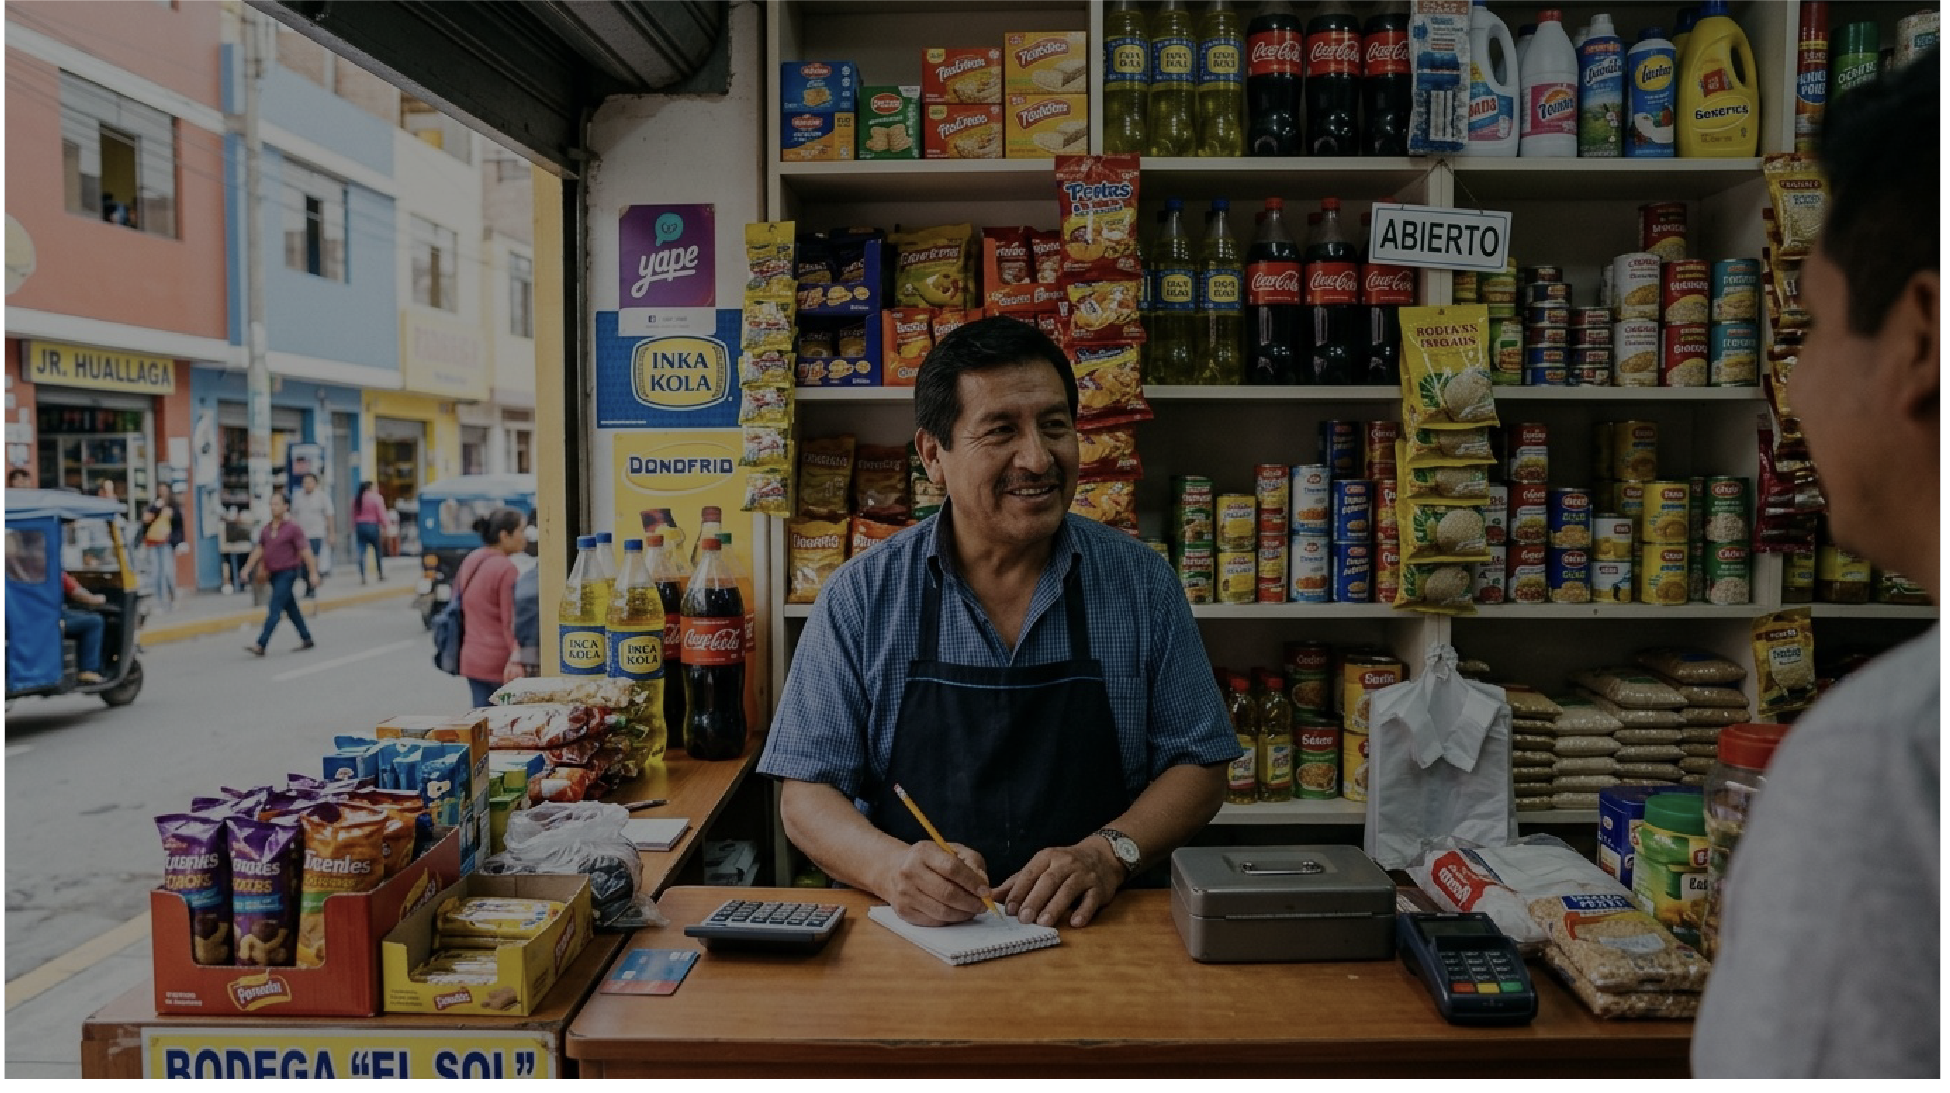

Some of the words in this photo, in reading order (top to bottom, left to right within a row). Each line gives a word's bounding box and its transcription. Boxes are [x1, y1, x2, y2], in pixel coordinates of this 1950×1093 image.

[1379, 219, 1499, 257] ABIERTO
[631, 245, 698, 298] yape
[37, 349, 67, 377] JR.
[75, 353, 171, 388] HUALLAGA
[652, 352, 709, 368] INKA
[651, 374, 712, 391] KOLA
[165, 1050, 336, 1079] BODEGA
